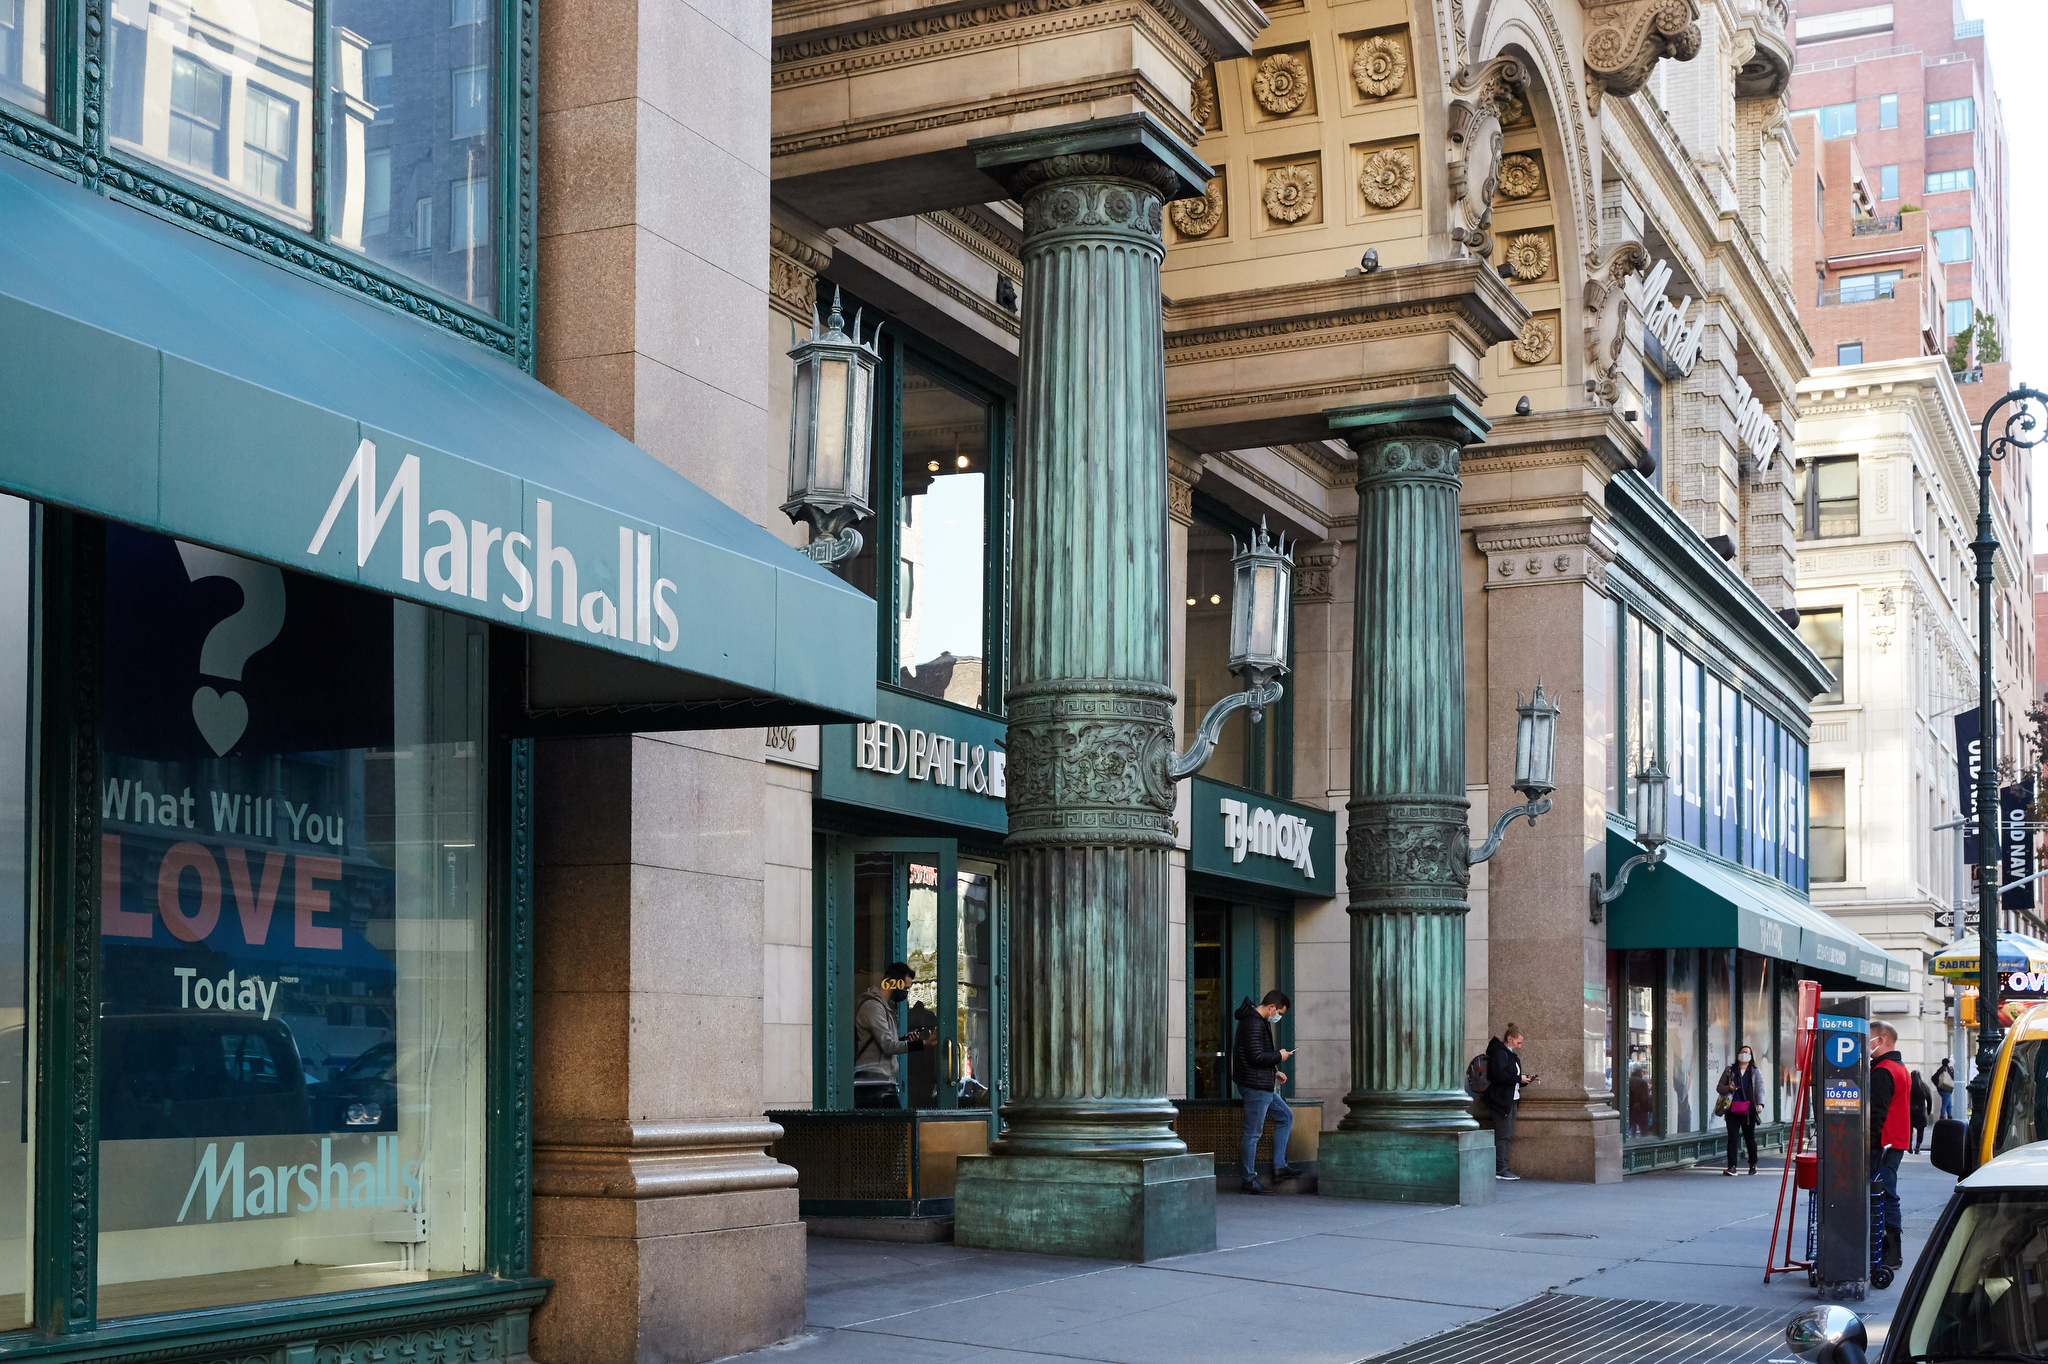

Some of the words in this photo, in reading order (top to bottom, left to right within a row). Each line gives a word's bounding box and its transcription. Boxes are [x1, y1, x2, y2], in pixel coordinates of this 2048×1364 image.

[1642, 258, 1707, 377] Marshalls
[306, 438, 680, 652] Marshalls
[857, 720, 907, 775] BED
[908, 729, 968, 791] BATH
[968, 744, 989, 794] &
[102, 777, 196, 830] What
[210, 790, 273, 838] Will
[284, 800, 344, 846] You
[2010, 808, 2026, 842] OLD
[101, 832, 344, 950] LOVE
[173, 967, 279, 1021] Today
[881, 977, 906, 990] 620
[1821, 1020, 1853, 1029] 106788
[1837, 1037, 1855, 1063] P
[1826, 1090, 1859, 1099] 106788
[176, 1135, 421, 1223] Marshalls
